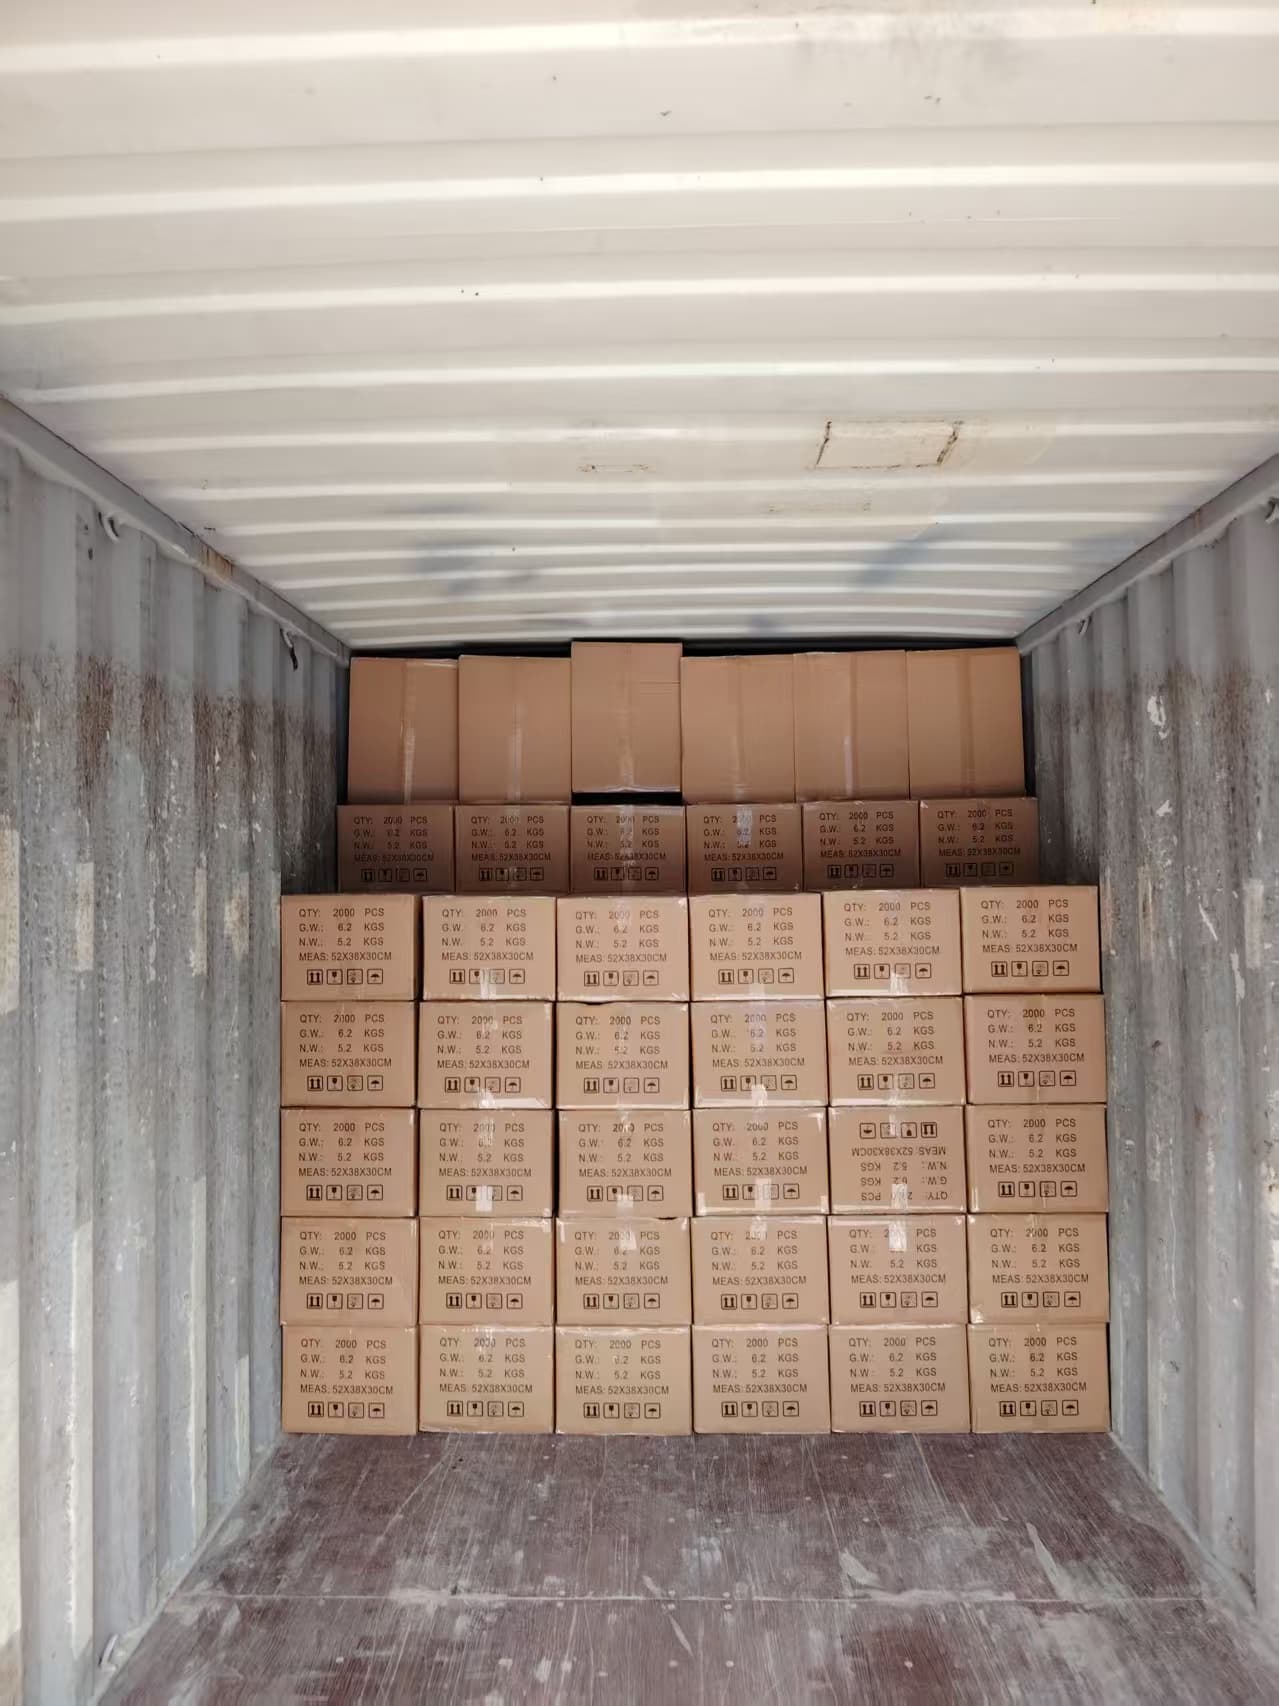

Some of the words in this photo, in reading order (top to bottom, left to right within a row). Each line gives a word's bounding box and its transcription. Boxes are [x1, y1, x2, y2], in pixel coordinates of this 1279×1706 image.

[849, 812, 868, 820] 2000
[876, 824, 894, 832] KGS
[878, 903, 901, 911] 2000
[911, 902, 931, 911] PCS
[1016, 900, 1039, 909] 2000
[1049, 899, 1069, 908] PCS
[333, 908, 355, 917] 2000
[365, 908, 384, 916] PCS
[884, 918, 898, 926] 6.2
[911, 917, 931, 926] KGS
[1021, 915, 1036, 923] 6.2
[1049, 914, 1069, 923] KGS
[338, 923, 352, 931] 6.2
[364, 923, 384, 931] KGS
[884, 932, 899, 940] 5.2
[911, 931, 931, 940] KGS
[1022, 930, 1036, 938] 5.2
[1048, 929, 1069, 937] KGS
[338, 938, 352, 946] 5.2
[364, 937, 383, 945] KGS
[881, 1012, 904, 1021] 2000
[914, 1011, 934, 1020] PCS
[1022, 1009, 1045, 1018] 2000
[1055, 1009, 1075, 1017] PCS
[365, 1014, 384, 1023] PCS
[887, 1027, 901, 1035] 6.2
[914, 1026, 934, 1035] KGS
[1028, 1024, 1042, 1032] 6.2
[1055, 1024, 1076, 1032] KGS
[338, 1029, 352, 1037] 6.2
[364, 1029, 384, 1038] KGS
[887, 1042, 902, 1050] 5.2
[914, 1041, 934, 1049] KGS
[1028, 1039, 1043, 1047] 5.2
[1055, 1038, 1076, 1047] KGS
[338, 1044, 352, 1052] 5.2
[364, 1043, 383, 1052] KGS
[1023, 1119, 1046, 1128] 2000
[1056, 1119, 1076, 1127] PCS
[1029, 1134, 1043, 1143] 6.2
[1056, 1134, 1077, 1143] KGS
[1029, 1149, 1044, 1157] 5.2
[1056, 1149, 1077, 1157] KGS
[860, 1163, 881, 1171] KGS
[334, 1232, 356, 1241] 2000
[366, 1232, 386, 1241] PCS
[339, 1247, 353, 1255] 6.2
[366, 1247, 386, 1256] KGS
[338, 1262, 353, 1270] 5.2
[365, 1261, 385, 1270] KGS
[613, 1262, 628, 1270] 5.2
[640, 1261, 660, 1269] KGS
[746, 1339, 768, 1348] 2000
[778, 1338, 798, 1347] PCS
[883, 1338, 906, 1347] 2000
[916, 1337, 936, 1346] PCS
[1024, 1338, 1047, 1347] 2000
[1057, 1337, 1077, 1346] PCS
[479, 1354, 493, 1362] 6.2
[505, 1354, 525, 1363] KGS
[751, 1354, 766, 1362] 6.2
[778, 1354, 799, 1362] KGS
[889, 1353, 903, 1361] 6.2
[916, 1352, 937, 1361] KGS
[1030, 1353, 1044, 1361] 6.2
[1057, 1352, 1078, 1361] KGS
[478, 1369, 492, 1377] 5.2
[505, 1369, 524, 1377] KGS
[752, 1369, 766, 1377] 5.2
[778, 1368, 798, 1377] KGS
[889, 1368, 904, 1376] 5.2
[916, 1367, 937, 1376] KGS
[1030, 1368, 1045, 1376] 5.2
[1057, 1367, 1078, 1376] KGS
